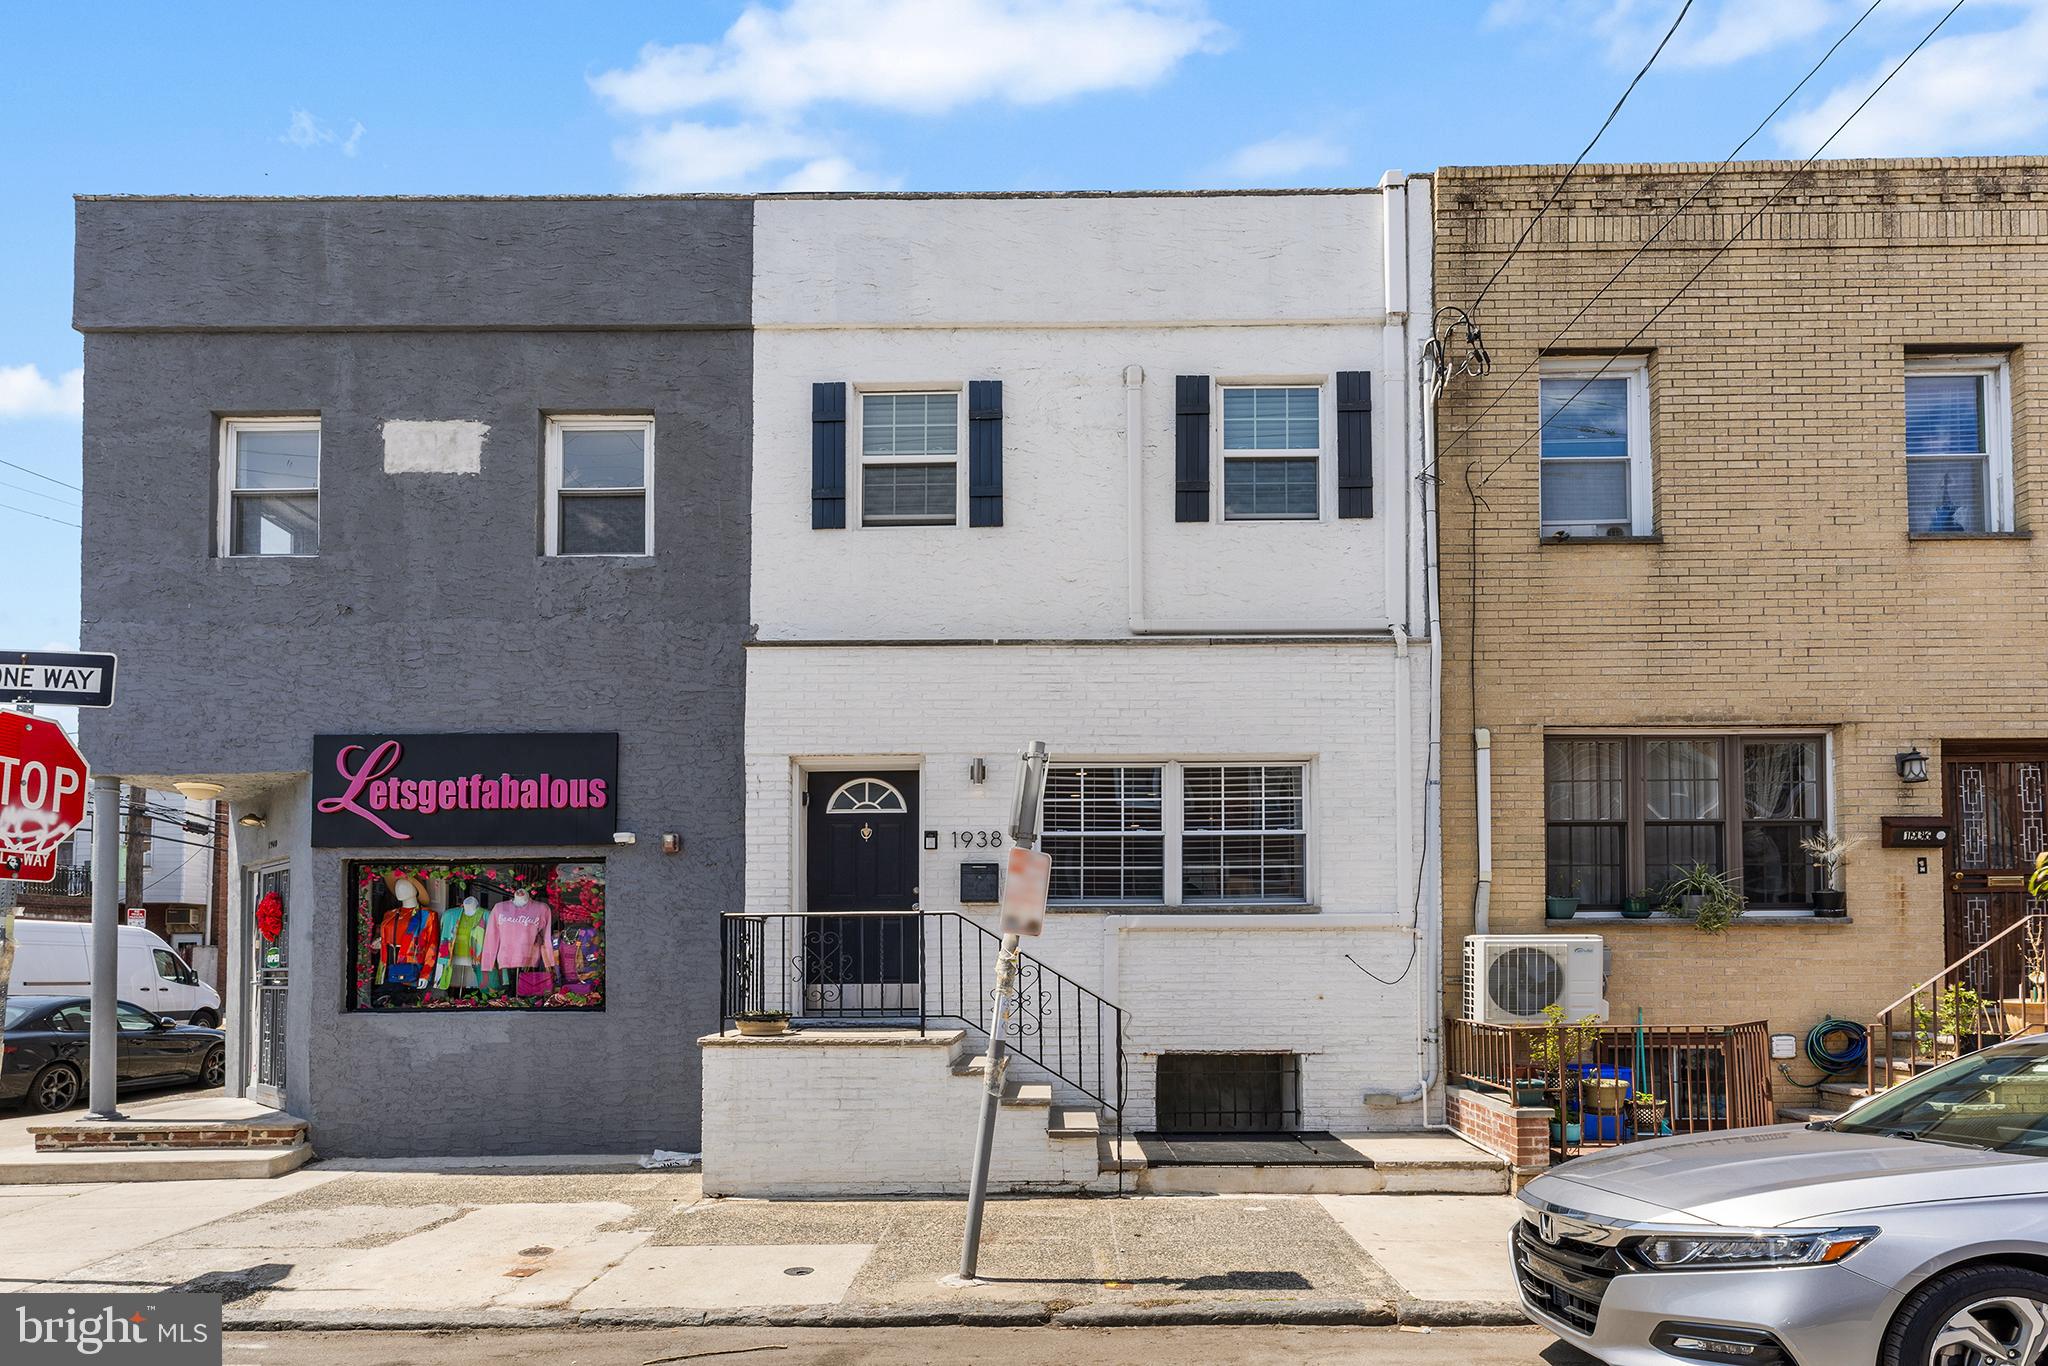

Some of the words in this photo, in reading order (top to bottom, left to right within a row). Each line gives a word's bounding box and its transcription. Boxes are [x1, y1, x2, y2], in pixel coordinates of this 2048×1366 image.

[0, 667, 35, 688] NE
[44, 668, 95, 690] WAY
[317, 740, 609, 839] Letsgetfabalous
[951, 830, 1002, 849] 1938
